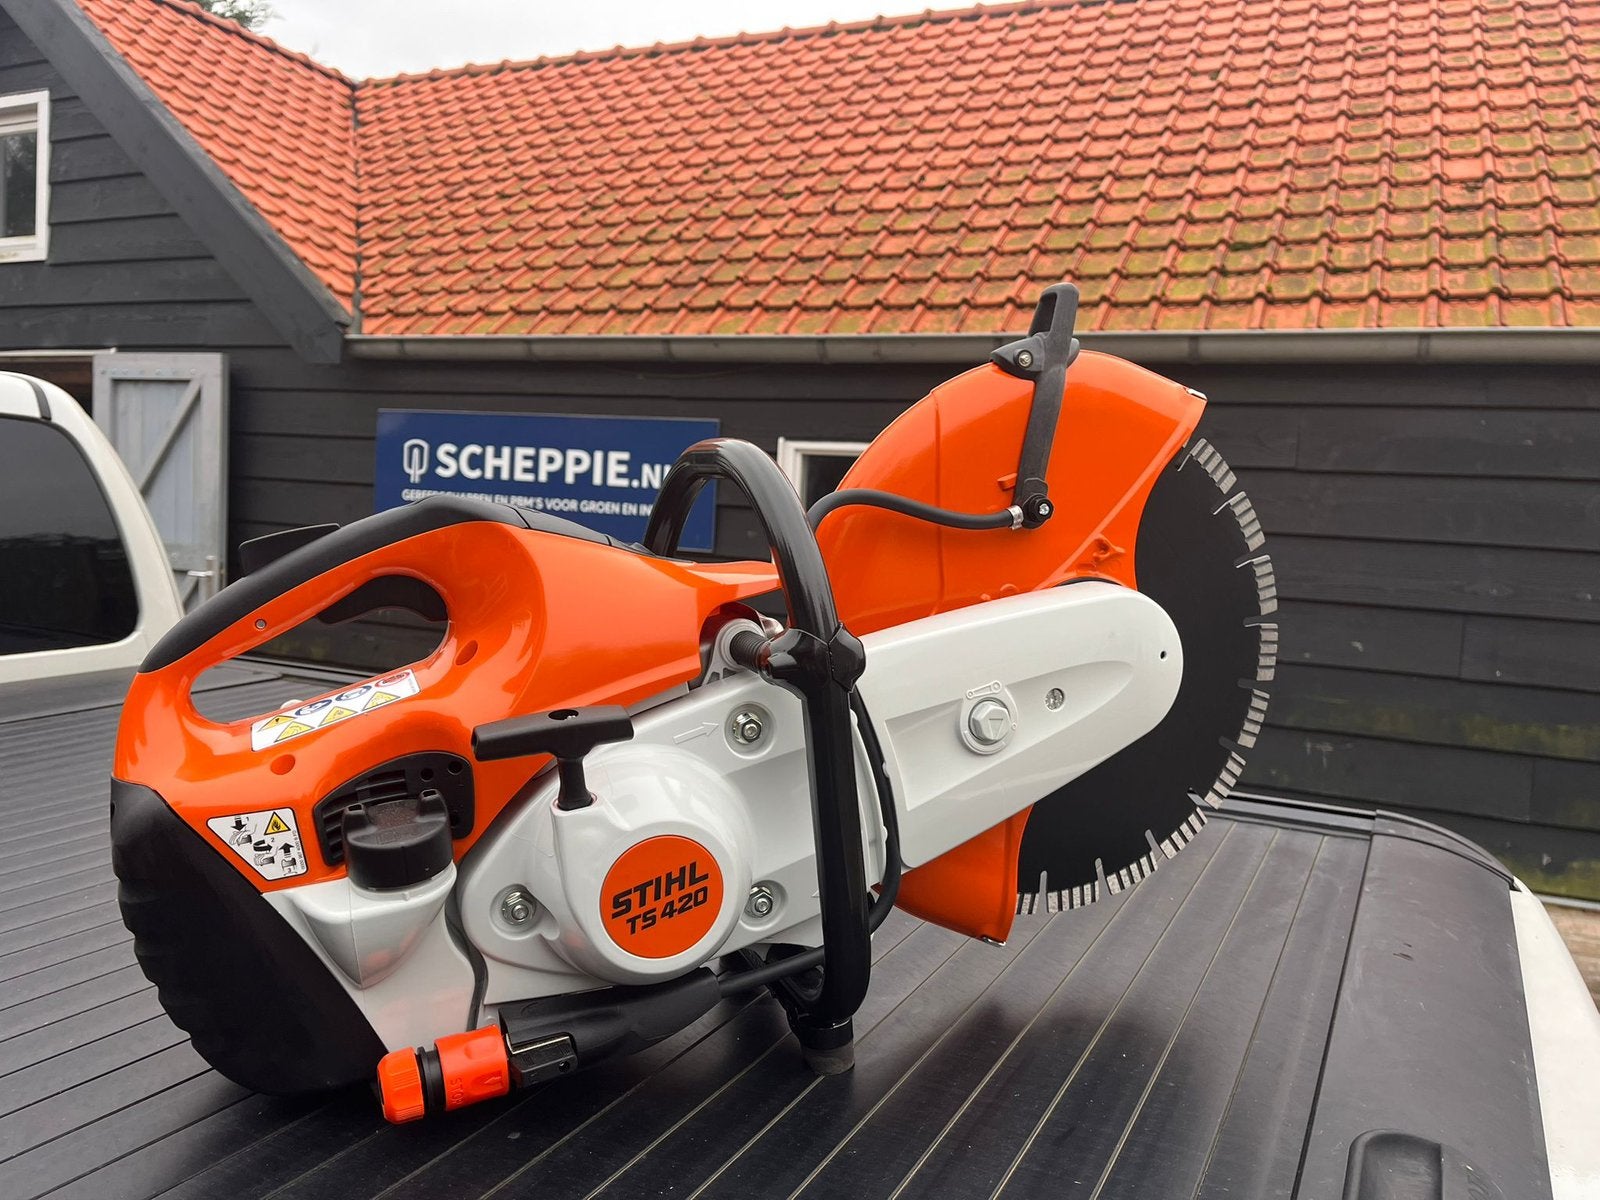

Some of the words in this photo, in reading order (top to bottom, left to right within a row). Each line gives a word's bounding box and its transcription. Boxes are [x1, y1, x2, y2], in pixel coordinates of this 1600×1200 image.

[545, 498, 578, 512] VOOR
[580, 499, 620, 515] GROEN
[622, 502, 638, 516] EN
[611, 861, 709, 919] STIHL
[626, 907, 657, 935] TS
[660, 886, 708, 919] 420
